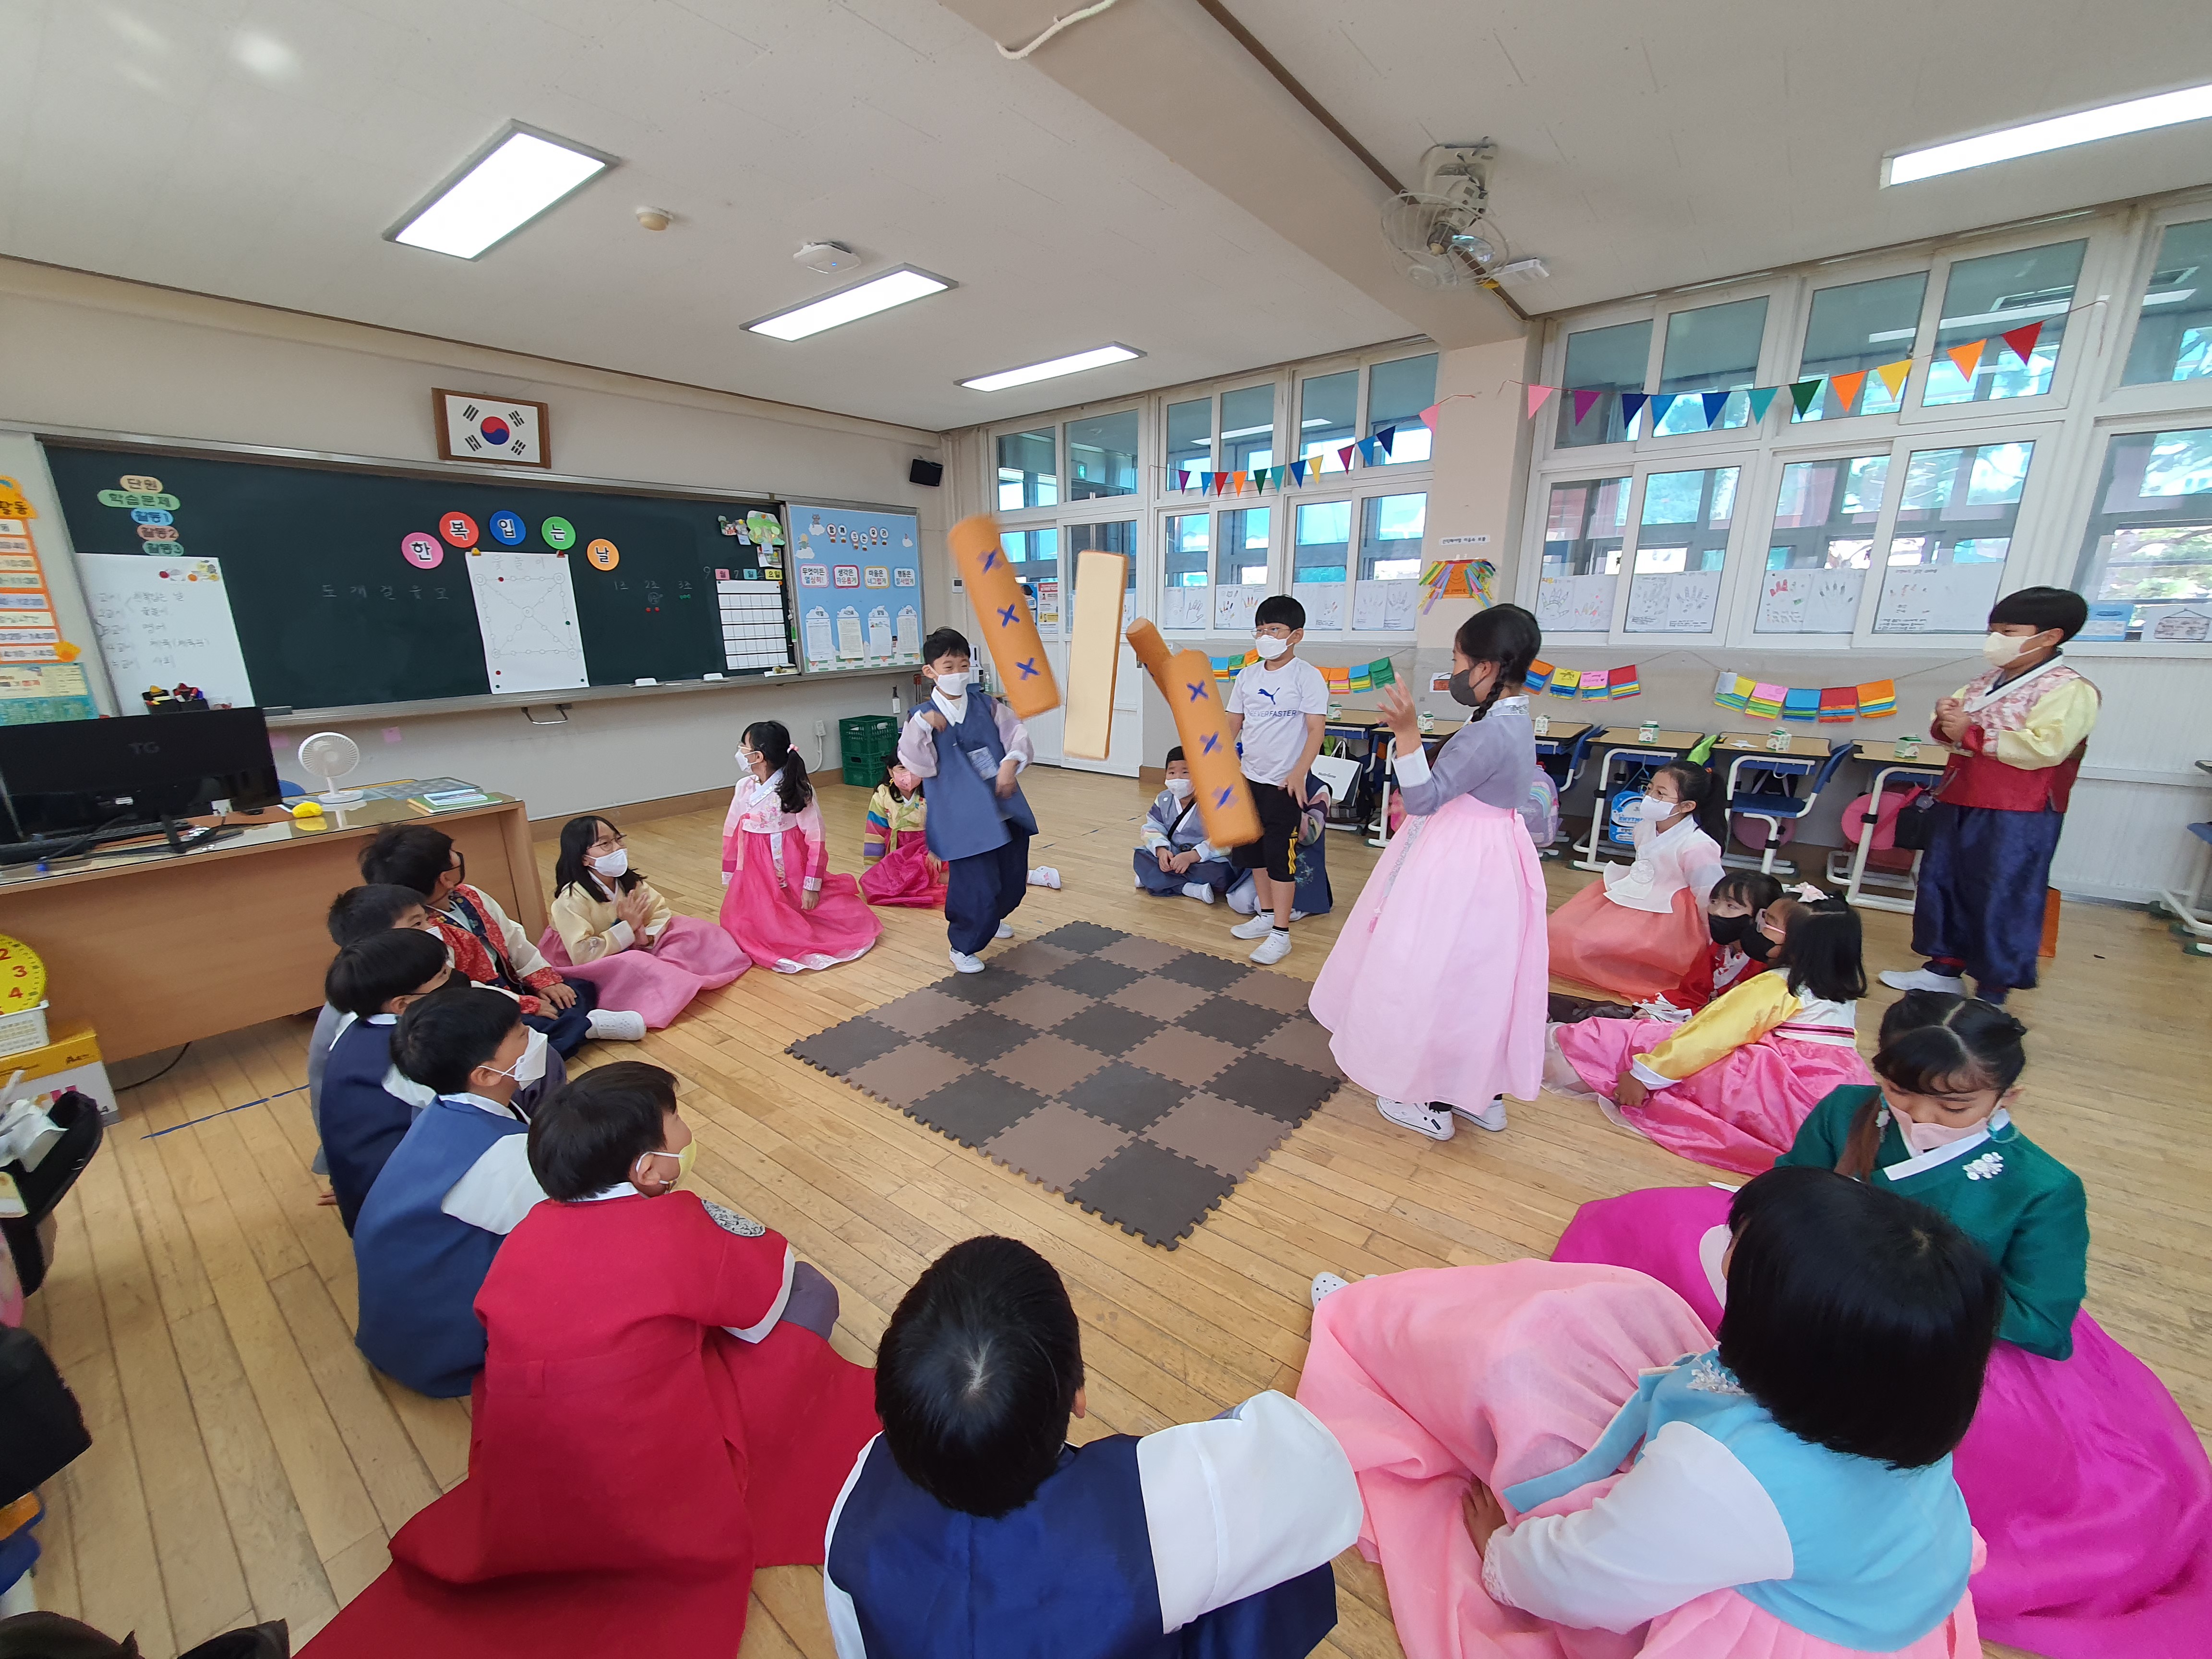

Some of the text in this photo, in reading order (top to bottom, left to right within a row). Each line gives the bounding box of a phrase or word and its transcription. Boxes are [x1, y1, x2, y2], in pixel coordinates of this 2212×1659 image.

[126, 478, 157, 491] 단원
[108, 493, 171, 507] 학습문제
[135, 511, 169, 523] 활동1
[141, 527, 177, 539] 활동2
[147, 543, 180, 554] 활동3
[703, 566, 711, 579] 9
[322, 584, 337, 597] 도
[128, 742, 160, 755] TG
[12, 965, 28, 978] 3
[8, 986, 24, 998] 4
